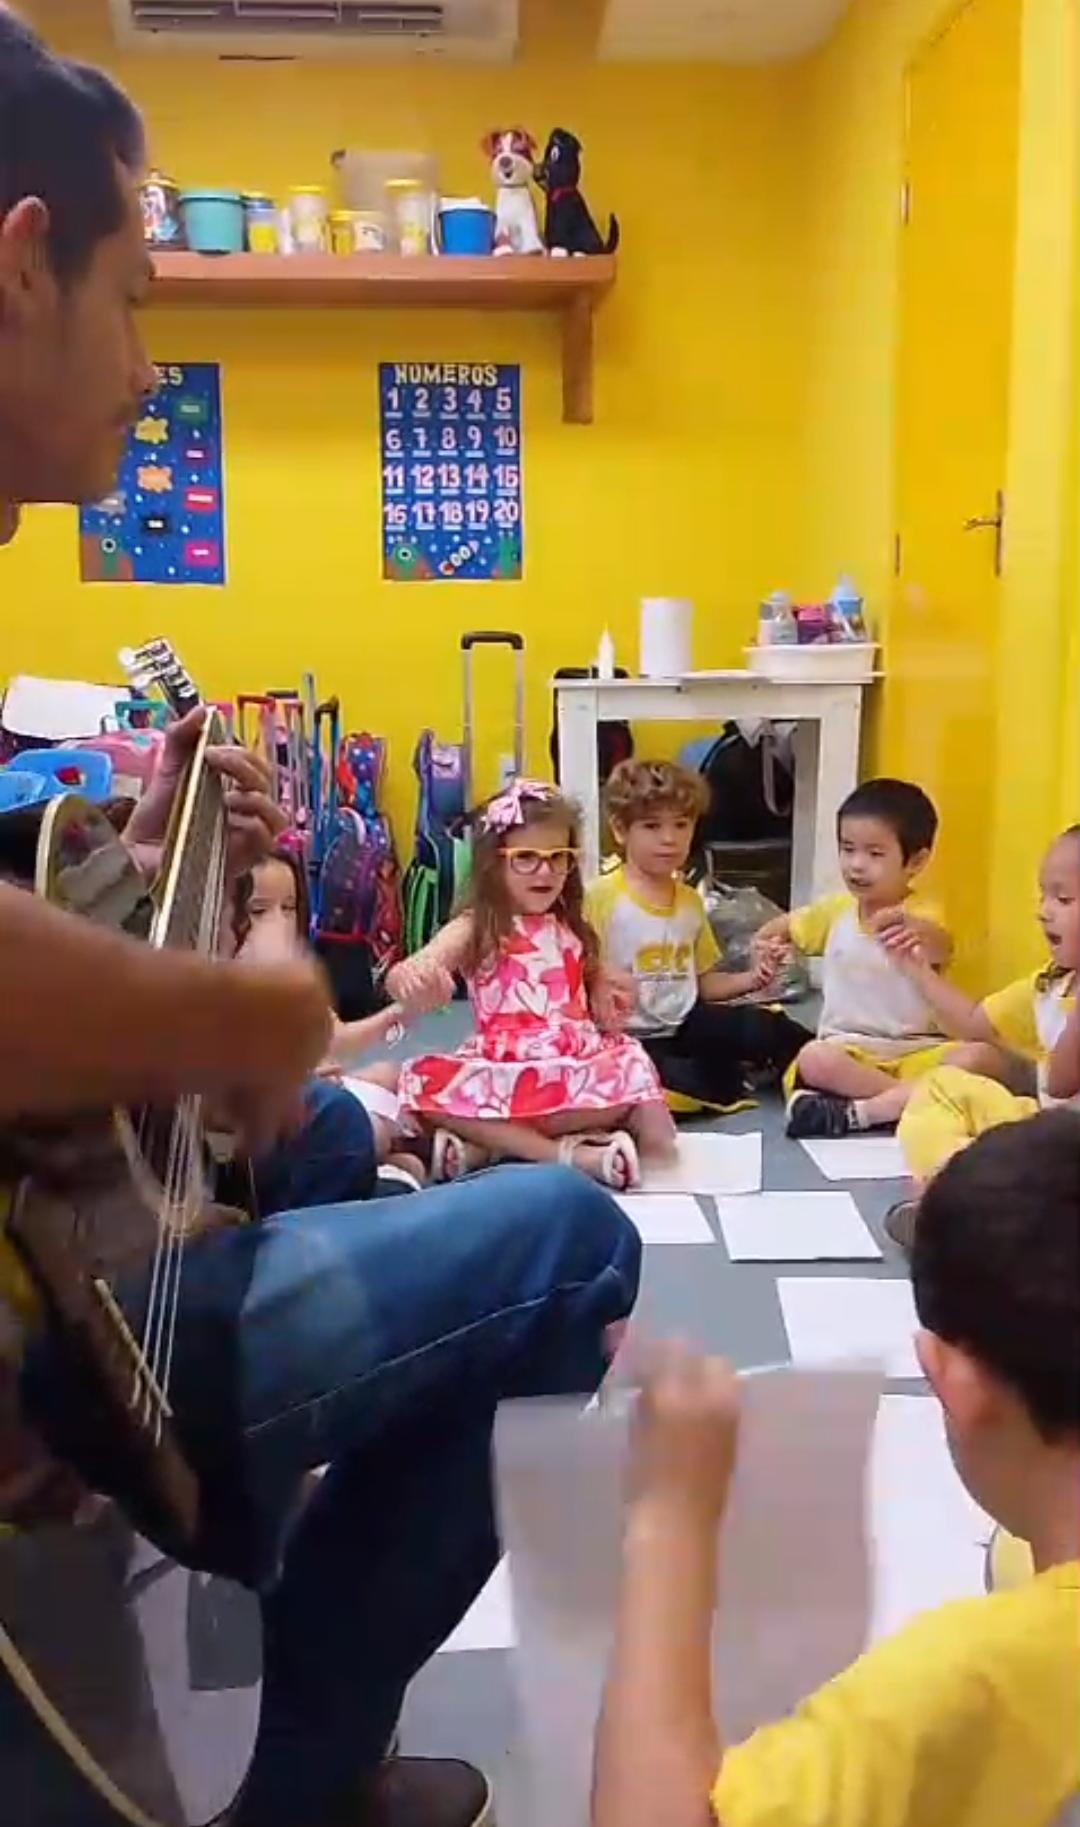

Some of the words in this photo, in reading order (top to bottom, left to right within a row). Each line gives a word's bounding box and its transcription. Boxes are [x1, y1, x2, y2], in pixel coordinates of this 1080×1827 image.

[387, 386, 399, 410] 1
[415, 387, 429, 409] 2
[443, 386, 457, 411] 3
[466, 388, 482, 412] 4
[496, 387, 512, 411] 5
[386, 429, 401, 450] 6
[413, 427, 426, 449] 7
[442, 427, 457, 449] 8
[467, 425, 482, 449] 9
[493, 425, 516, 447] 10
[383, 464, 404, 488] 11
[411, 464, 434, 488] 12
[438, 463, 460, 488] 13
[463, 464, 489, 488] 14
[493, 464, 518, 488] 15
[384, 502, 407, 523] 16
[411, 501, 436, 523] 17
[439, 501, 463, 523] 18
[465, 499, 489, 523] 19
[494, 498, 518, 521] 20
